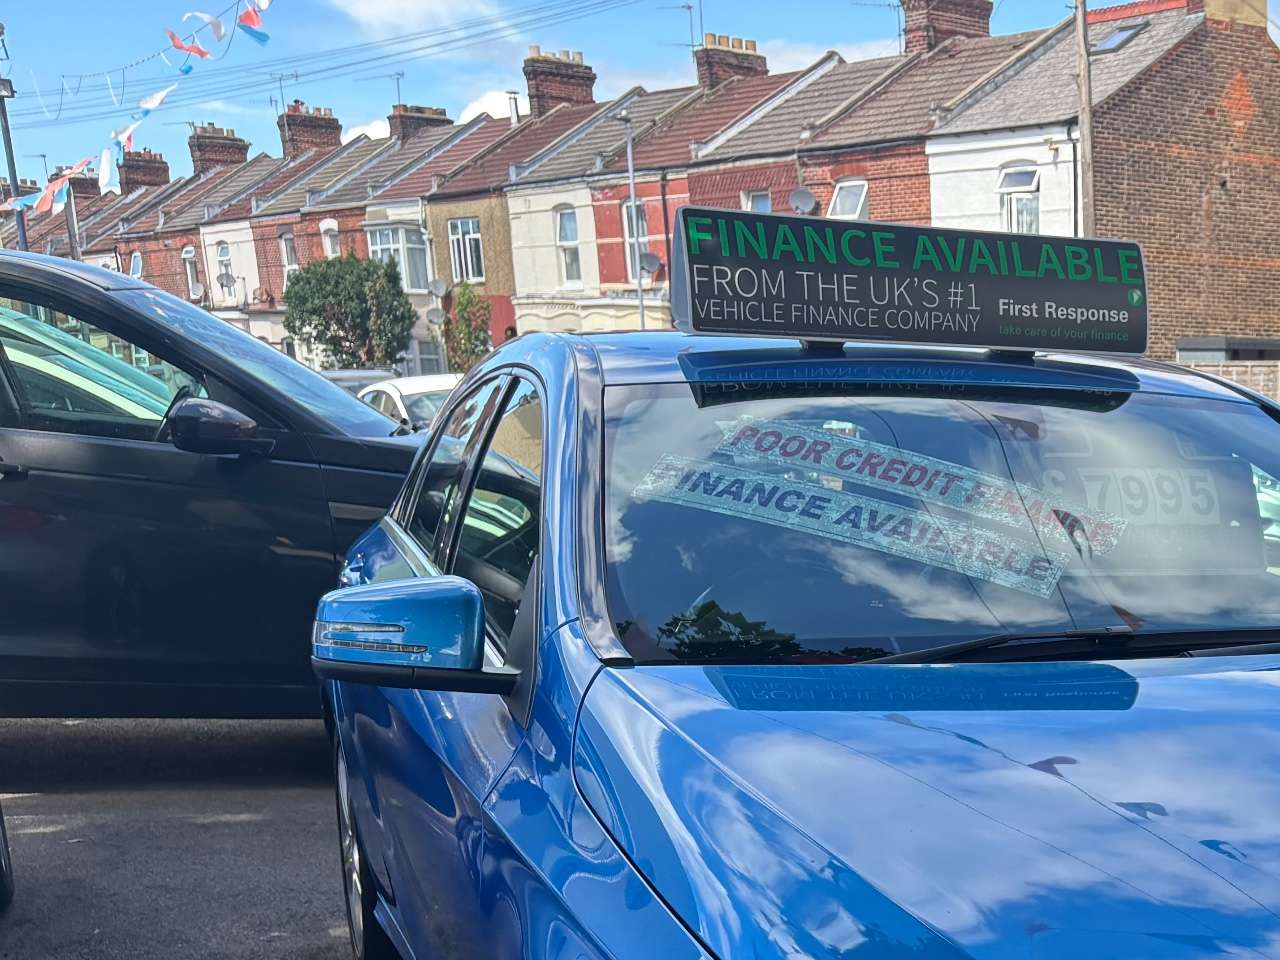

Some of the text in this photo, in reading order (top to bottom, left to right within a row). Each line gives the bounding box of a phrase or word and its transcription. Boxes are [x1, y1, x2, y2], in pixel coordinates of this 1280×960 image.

[686, 216, 1143, 285] FINANCE AVAILABLE
[693, 264, 981, 310] FROM THE UK'S #1
[695, 298, 785, 322] VEHICLE
[791, 303, 880, 328] FINANCE
[884, 309, 981, 333] COMPANY
[999, 298, 1129, 324] First Response
[1000, 325, 1129, 341] take care of your finance
[730, 425, 831, 464] POOR
[835, 448, 965, 496] CREDIT
